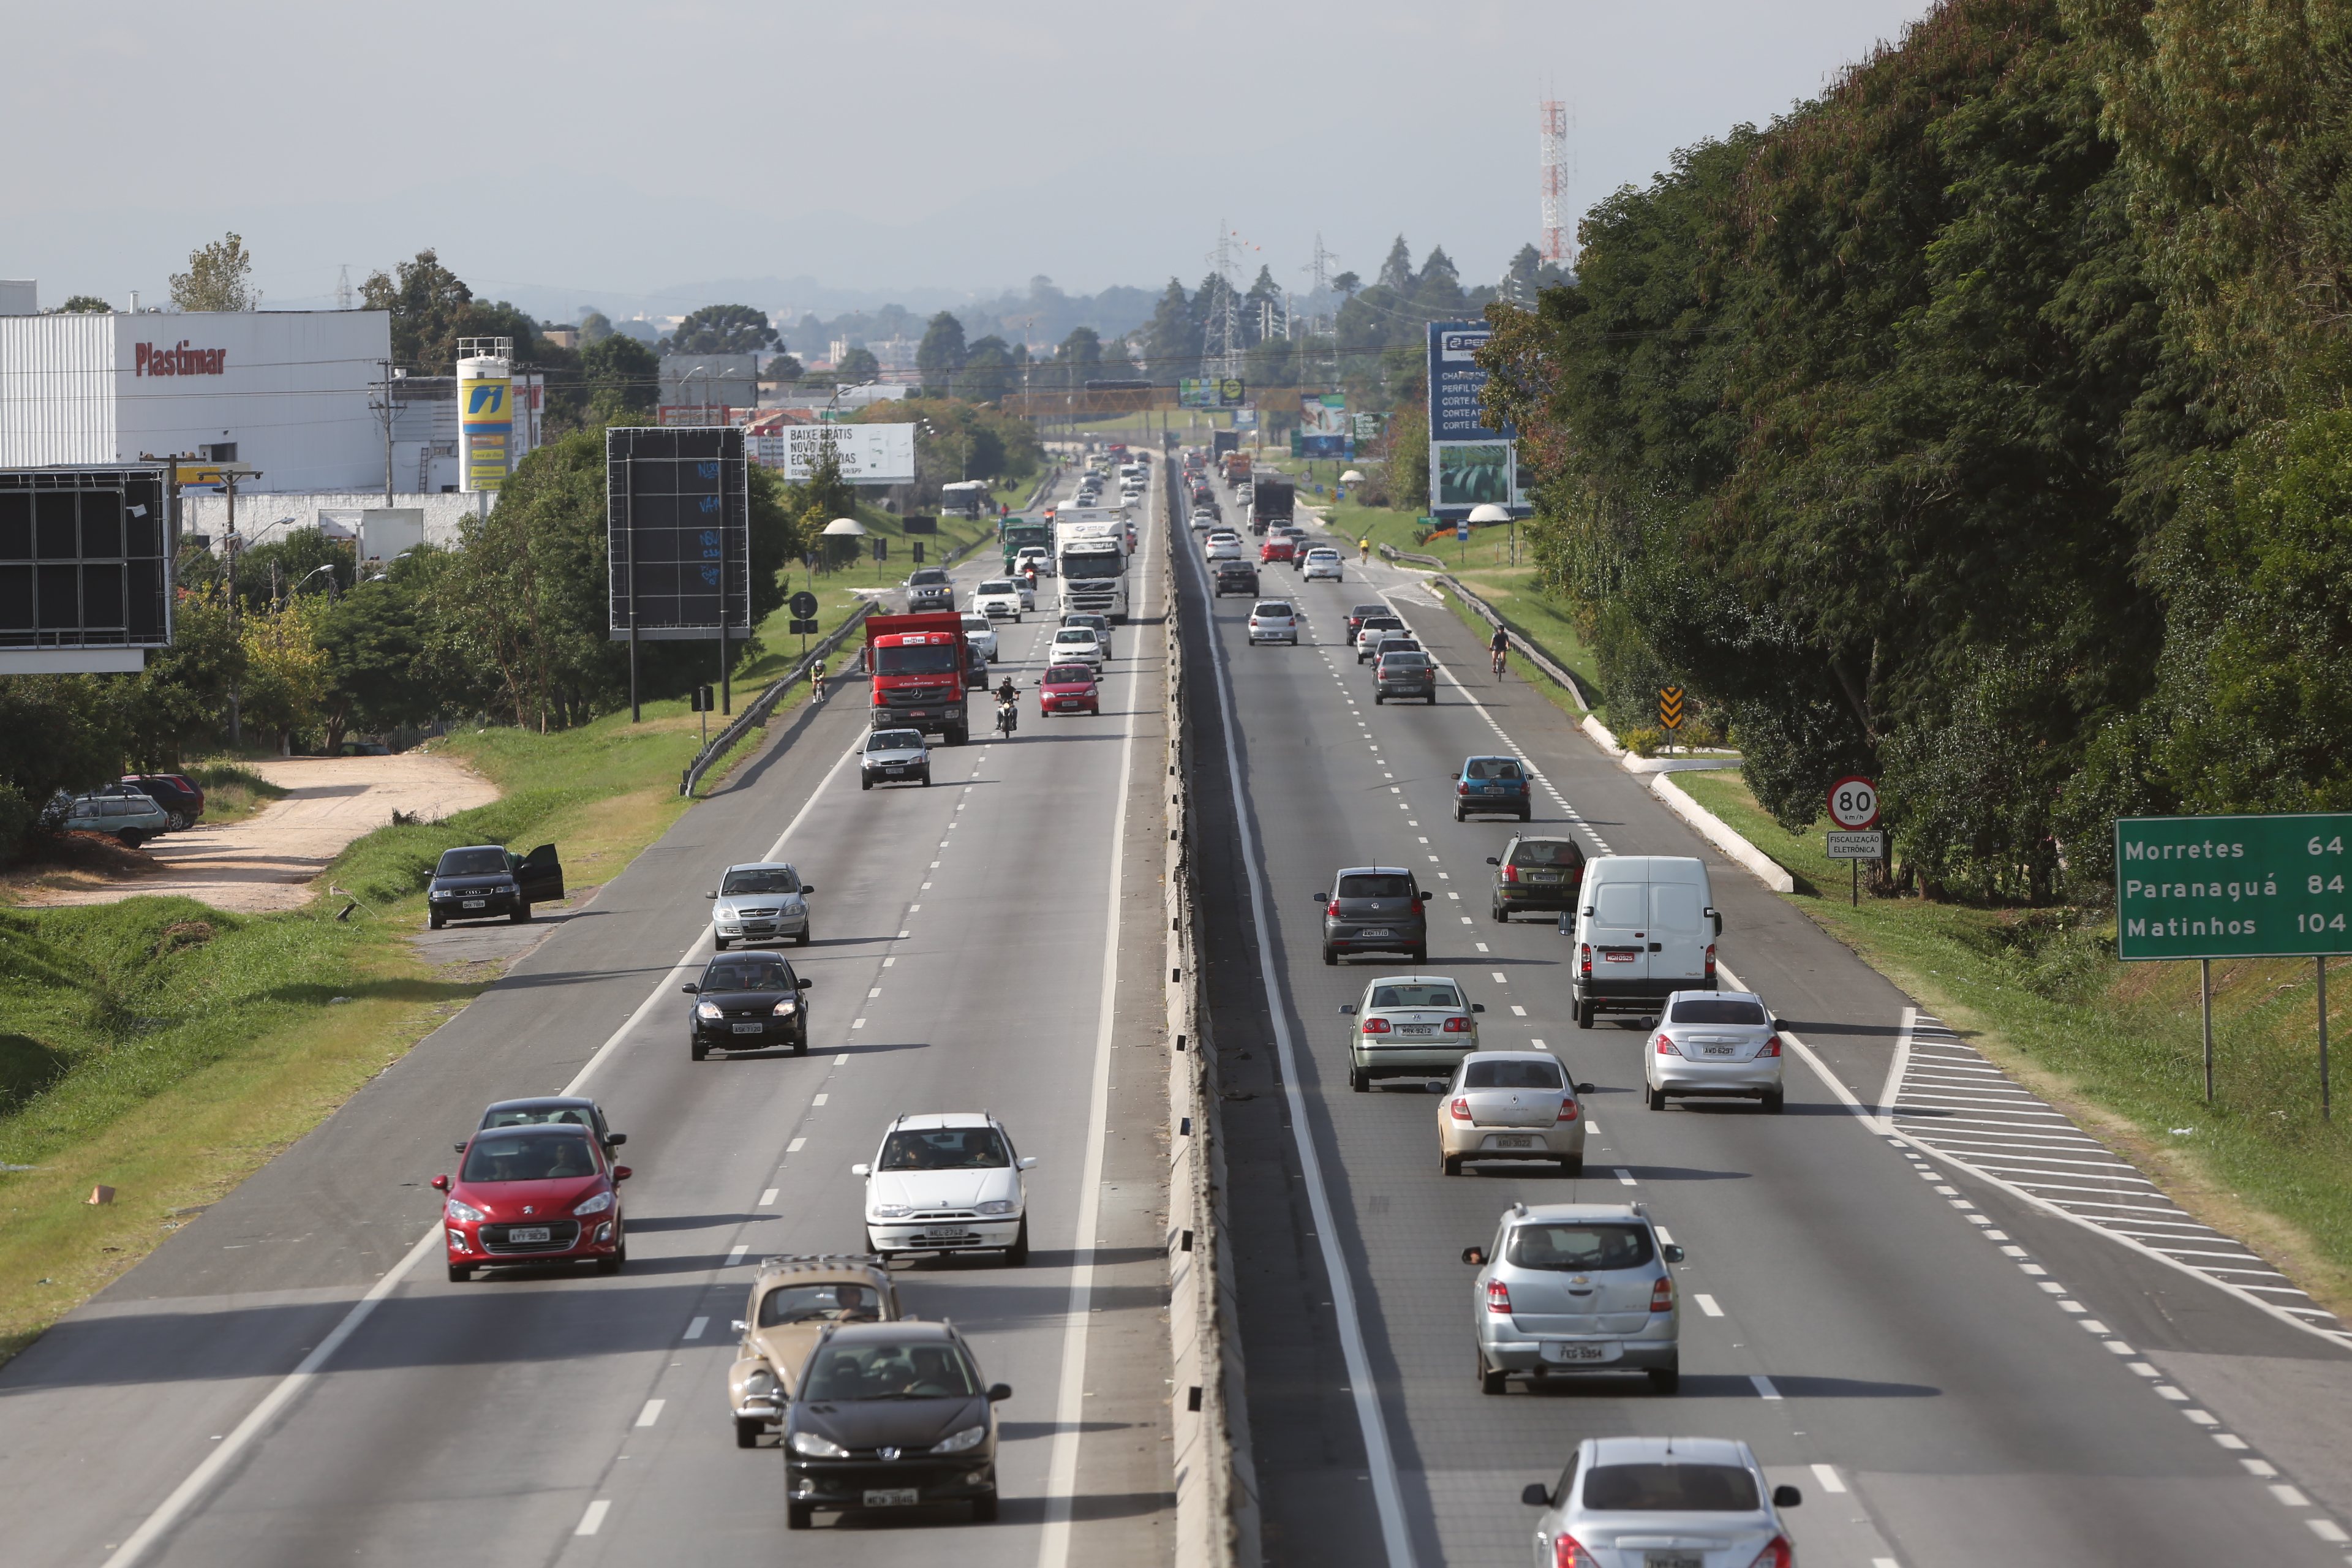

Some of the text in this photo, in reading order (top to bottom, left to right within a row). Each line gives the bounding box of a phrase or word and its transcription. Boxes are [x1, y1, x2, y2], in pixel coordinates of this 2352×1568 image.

[135, 340, 226, 377] Plastimar
[1442, 397, 1469, 405] CORTE
[1443, 421, 1470, 429] CORTE
[791, 429, 818, 440] BAIXE
[791, 442, 816, 453] NOVO
[1839, 791, 1871, 812] 80
[1830, 835, 1879, 843] FISCALIZAÇÃO
[2125, 836, 2343, 860] Morretes 64
[2127, 873, 2345, 902] Paranaguá 84
[2128, 913, 2346, 937] Matinhos 104
